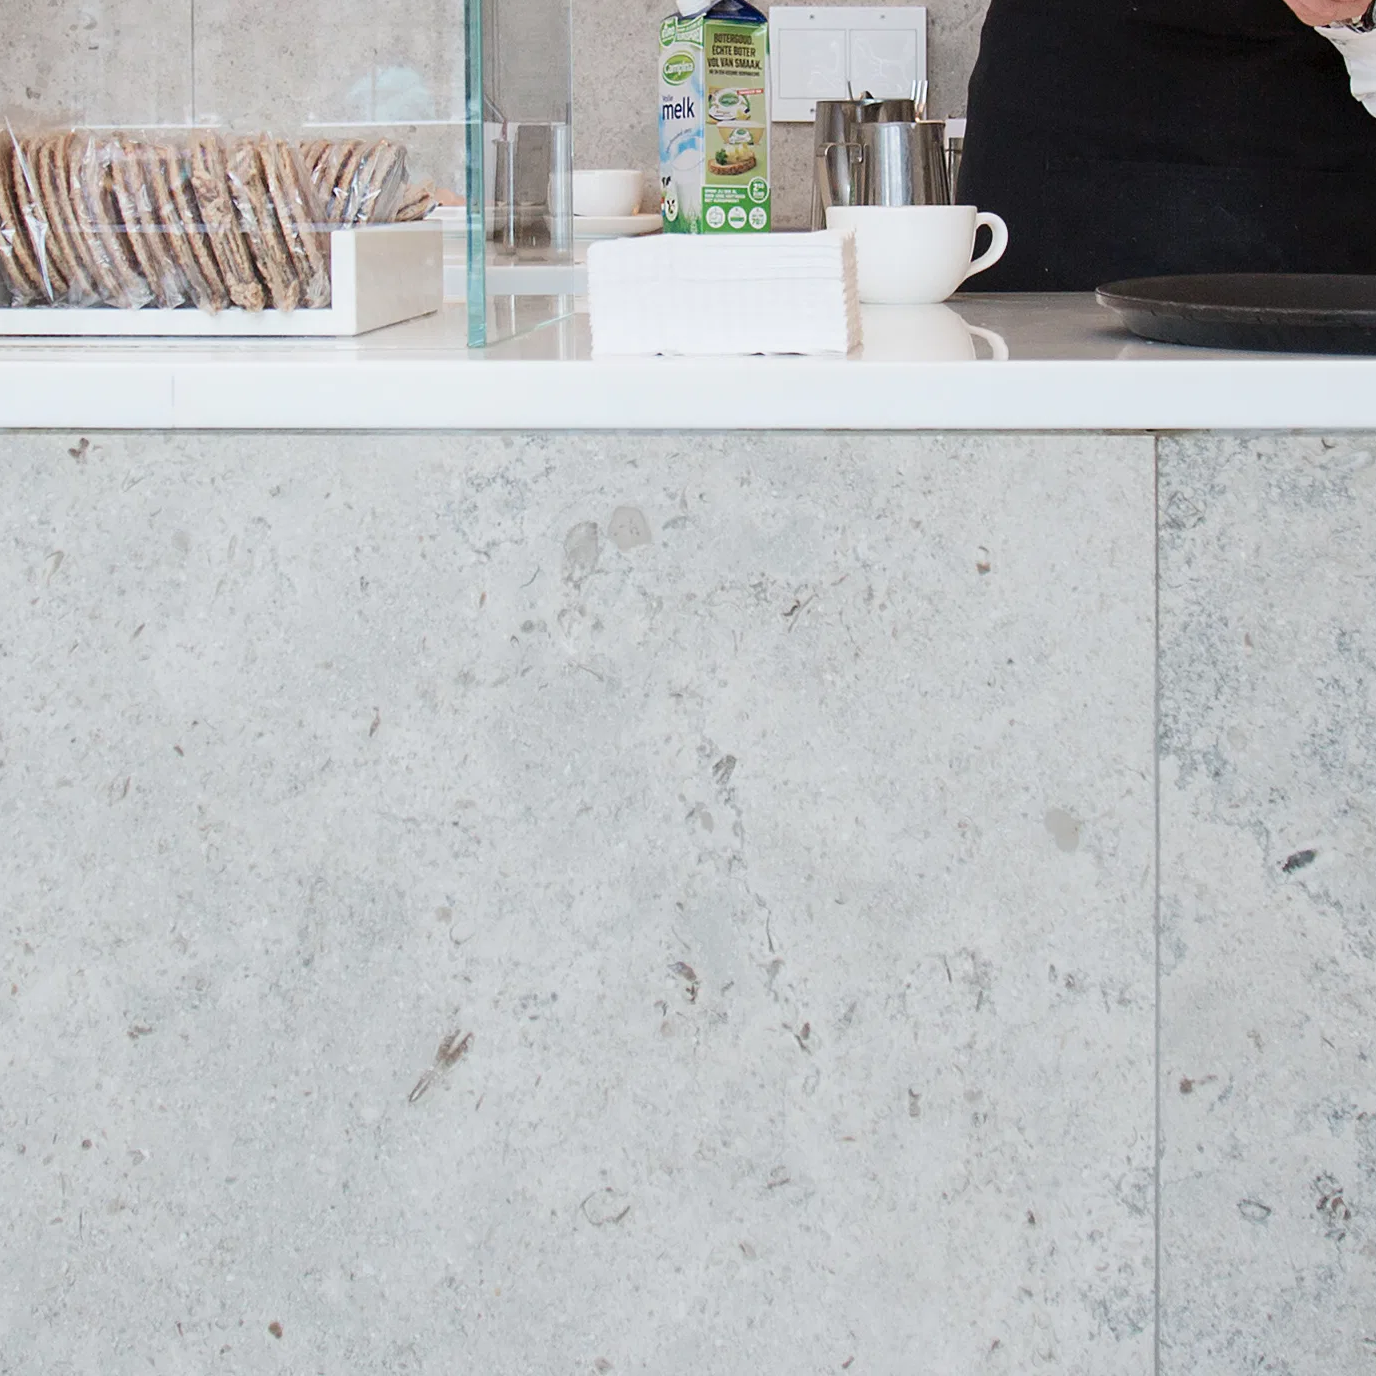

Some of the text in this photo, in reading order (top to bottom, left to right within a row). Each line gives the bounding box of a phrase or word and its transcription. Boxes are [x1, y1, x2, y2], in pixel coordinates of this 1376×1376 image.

[714, 32, 754, 45] BOTERGOUD.
[711, 44, 757, 58] ECHTE BOTER
[707, 57, 763, 71] VOL VAN SMAAK.
[662, 96, 696, 121] melk
